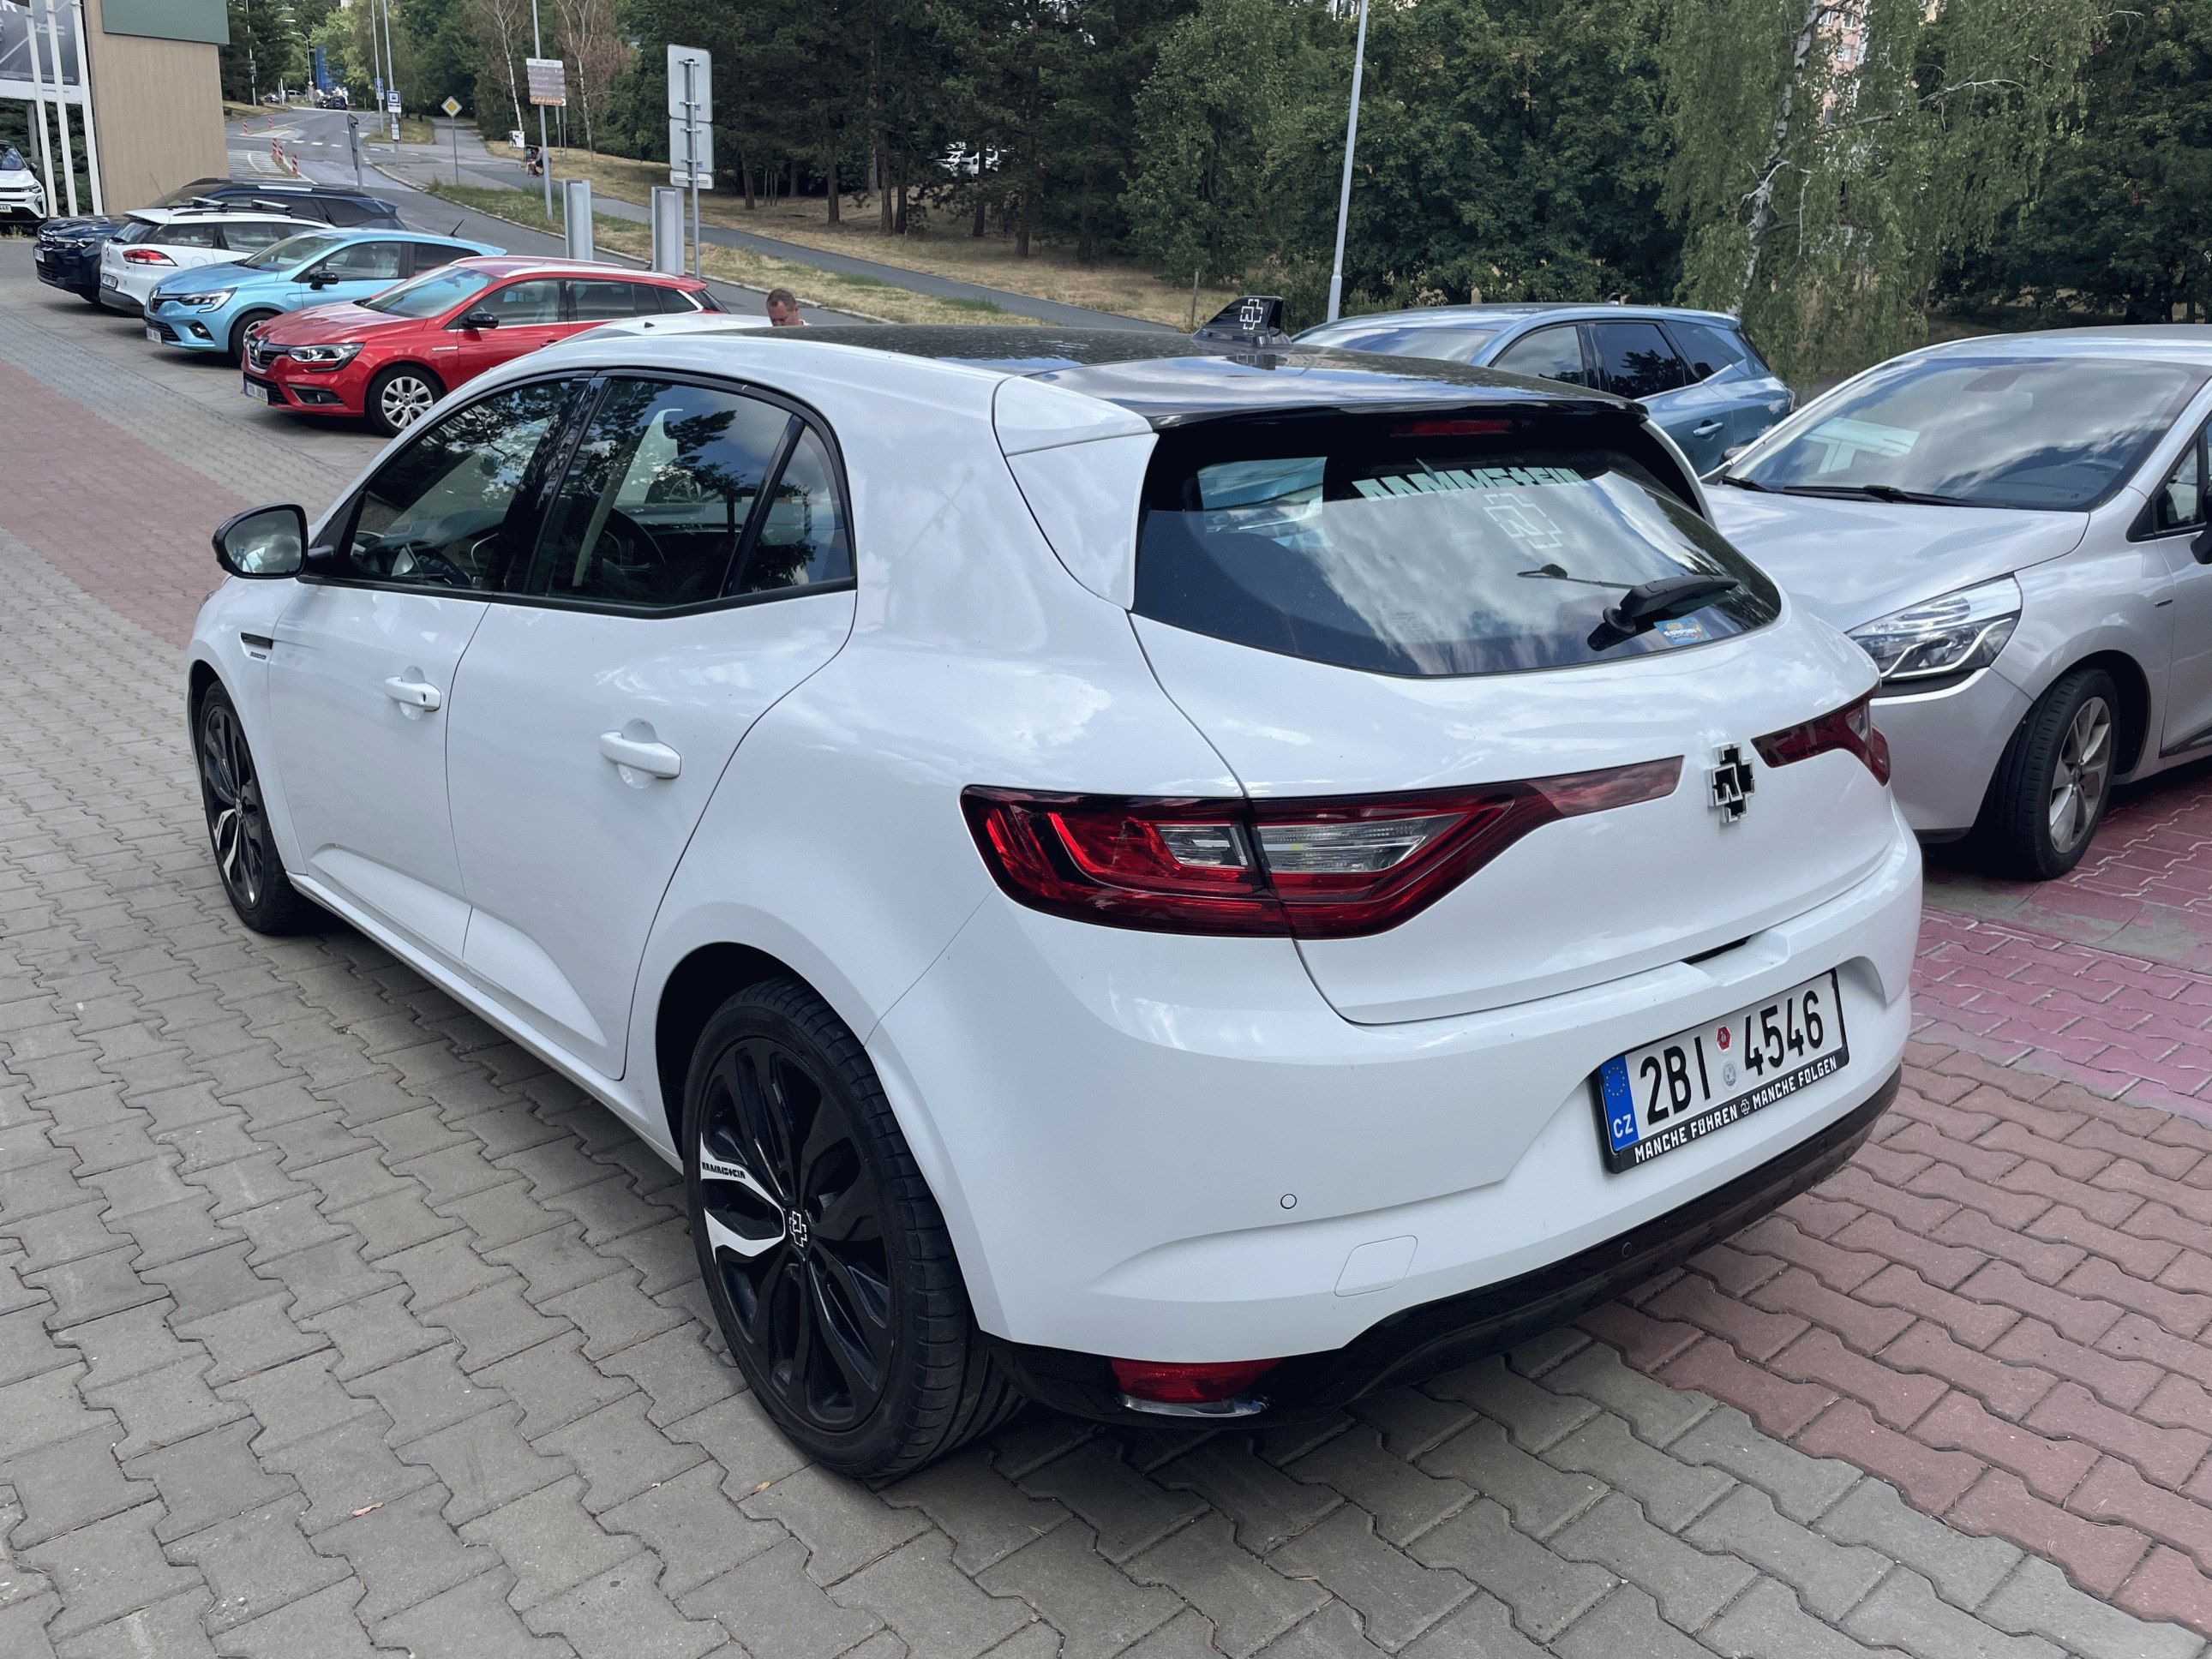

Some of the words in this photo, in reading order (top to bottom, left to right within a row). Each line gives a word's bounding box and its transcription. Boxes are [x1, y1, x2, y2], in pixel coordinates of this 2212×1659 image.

[1352, 467, 1590, 501] RAMMSTEIN
[1640, 1036, 1711, 1126] 2BI
[1745, 990, 1824, 1076] 4546
[1613, 1113, 1634, 1139] CZ
[1634, 1126, 1687, 1164] MANCHE
[1690, 1104, 1738, 1139] FÜHREN
[1752, 1075, 1796, 1110] MANCHE
[1797, 1055, 1837, 1087] FOLGEN
